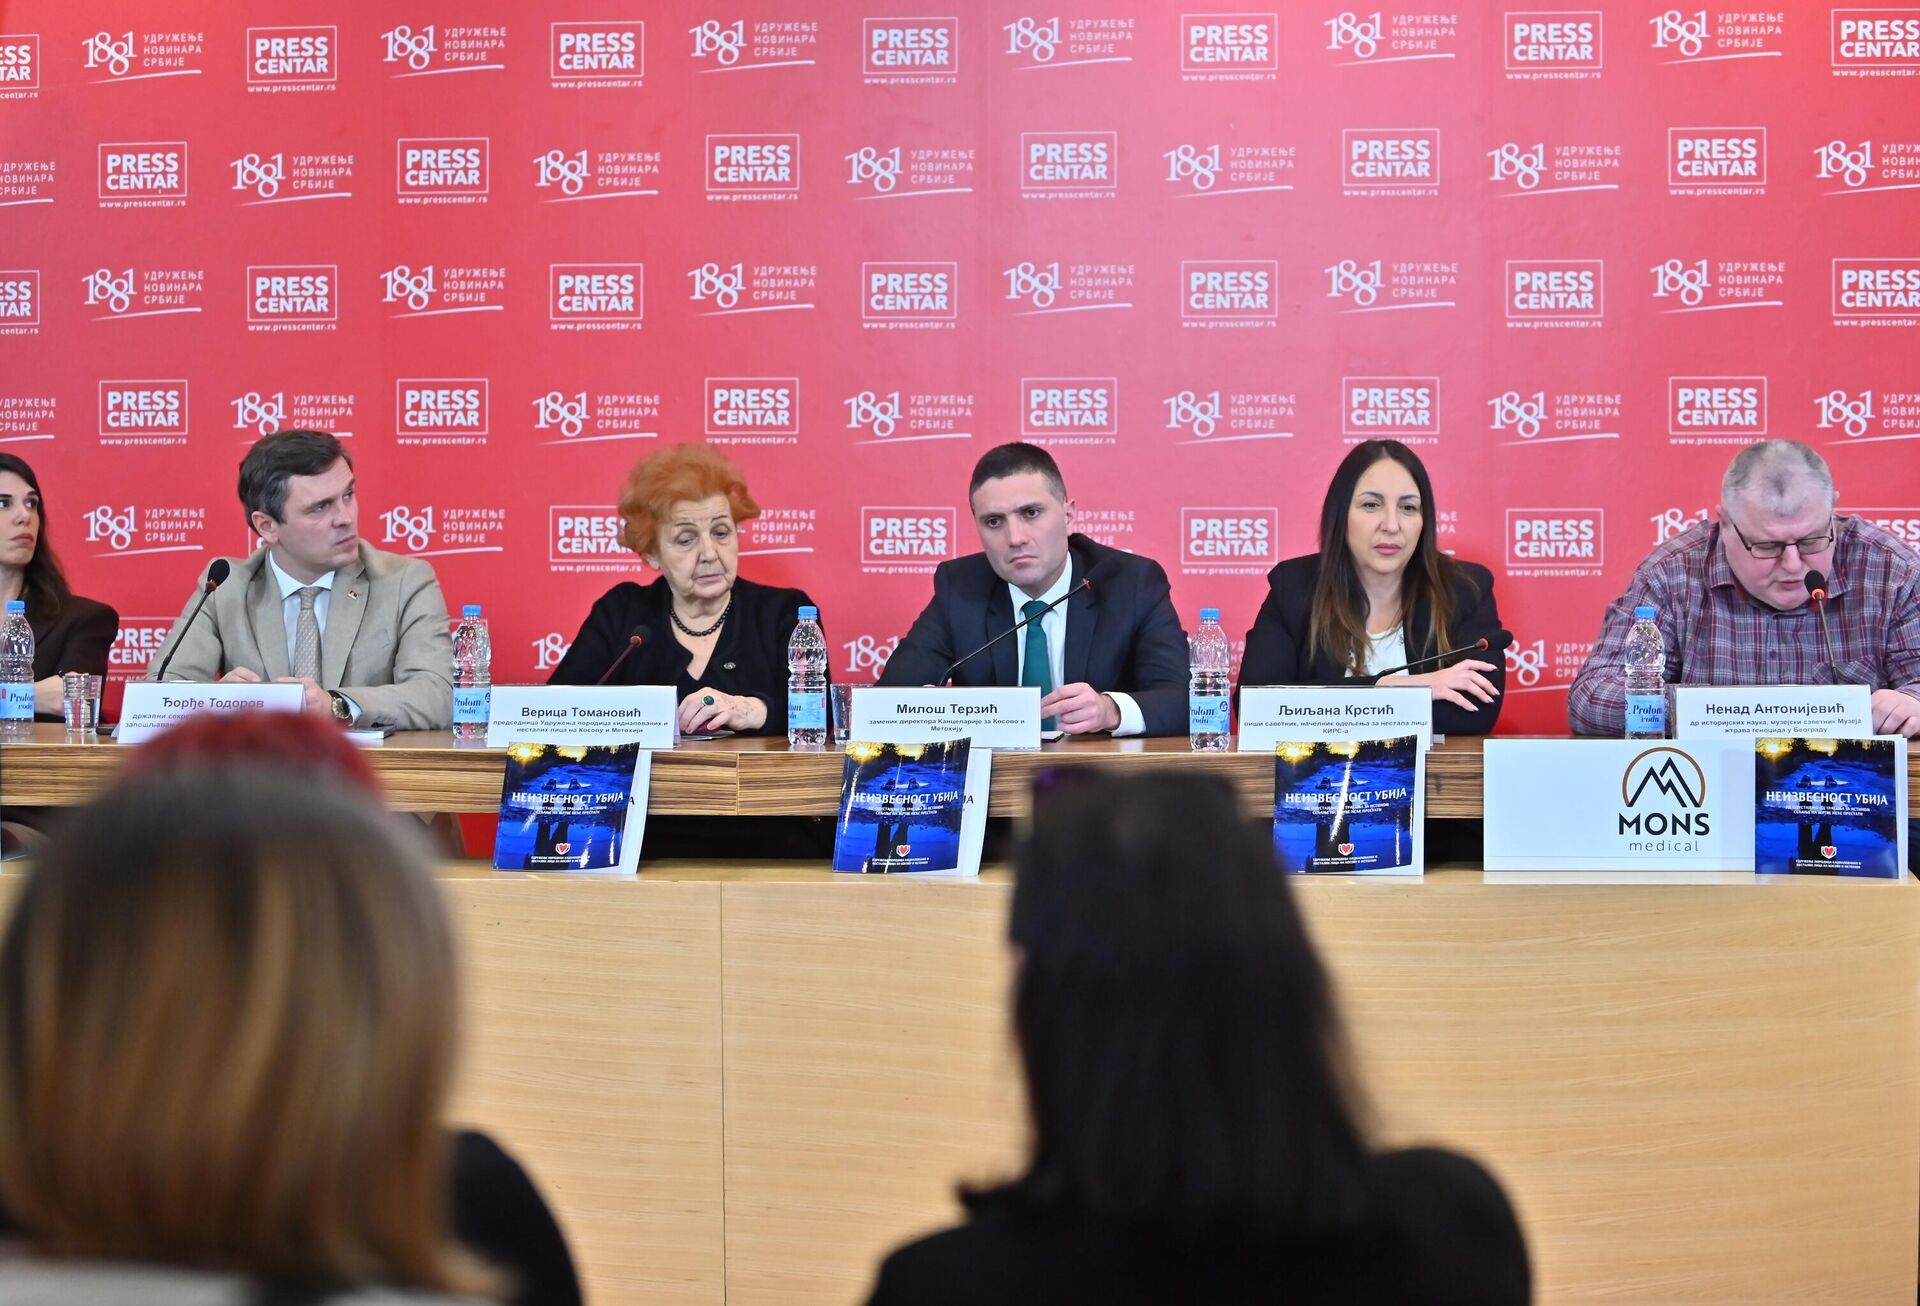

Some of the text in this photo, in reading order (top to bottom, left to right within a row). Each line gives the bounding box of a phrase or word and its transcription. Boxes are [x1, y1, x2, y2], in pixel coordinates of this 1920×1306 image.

[1392, 15, 1457, 25] УДРУЖЕЊЕ
[754, 22, 817, 33] УДРУЖЕЊЕ
[1392, 27, 1455, 37] НОВИНАРА
[1514, 23, 1593, 43] PRESS
[144, 32, 203, 44] УДРУЖЕЊЕ
[754, 35, 816, 44] НОВИНАРА
[872, 28, 949, 48] PRESS
[1324, 12, 1384, 57] 1881
[256, 37, 328, 57] PRESS
[689, 20, 747, 65] 1881
[1392, 40, 1436, 49] СРБИЈЕ
[82, 31, 136, 75] 1881
[144, 44, 202, 55] НОВИНАРА
[754, 47, 797, 56] СРБИЈЕ
[1514, 44, 1592, 61] CENTAR
[144, 57, 184, 67] СРБИЈЕ
[872, 50, 948, 65] CENTAR
[255, 57, 328, 74] CENTAR
[1506, 72, 1601, 80] www.presscentar.rs
[248, 84, 336, 93] www.presscentar.rs
[715, 145, 790, 165] PRESS
[912, 150, 974, 160] УДРУЖЕЊЕ
[1352, 140, 1430, 160] PRESS
[1555, 146, 1621, 156] УДРУЖЕЊЕ
[107, 152, 178, 173] PRESS
[293, 155, 354, 166] УДРУЖЕЊЕ
[911, 162, 973, 171] НОВИНАРА
[1487, 143, 1547, 189] 1881
[1555, 158, 1619, 168] НОВИНАРА
[230, 153, 286, 197] 1881
[293, 167, 352, 177] НОВИНАРА
[714, 166, 790, 182] CENTAR
[845, 147, 902, 192] 1881
[1351, 161, 1430, 177] CENTAR
[1555, 171, 1600, 180] СРБИЈЕ
[106, 173, 178, 190] CENTAR
[293, 179, 334, 189] СРБИЈЕ
[911, 175, 954, 183] СРБИЈЕ
[1344, 188, 1438, 196] www.presscentar.rs
[99, 200, 186, 208] www.presscentar.rs
[753, 266, 816, 276] УДРУЖЕЊЕ
[1393, 263, 1457, 273] УДРУЖЕЊЕ
[559, 274, 634, 295] PRESS
[688, 263, 746, 308] 1881
[753, 278, 814, 288] НОВИНАРА
[1191, 272, 1268, 291] PRESS
[1325, 260, 1384, 305] 1881
[1393, 276, 1456, 285] НОВИНАРА
[753, 290, 796, 300] СРБИЈЕ
[1393, 288, 1437, 297] СРБИЈЕ
[558, 296, 634, 312] CENTAR
[1190, 293, 1268, 309] CENTAR
[551, 323, 641, 331] www.presscentar.rs
[406, 389, 479, 409] PRESS
[597, 395, 660, 406] УДРУЖЕЊЕ
[1031, 389, 1107, 409] PRESS
[1231, 394, 1295, 404] УДРУЖЕЊЕ
[405, 409, 479, 426] CENTAR
[532, 392, 590, 437] 1881
[597, 407, 658, 417] НОВИНАРА
[1030, 410, 1107, 426] CENTAR
[1163, 391, 1222, 437] 1881
[1231, 407, 1294, 416] НОВИНАРА
[597, 419, 639, 429] СРБИЈЕ
[1231, 419, 1274, 428] СРБИЈЕ
[397, 437, 487, 445] www.presscentar.rs
[145, 508, 205, 519] УДРУЖЕЊЕ
[83, 505, 138, 550] 1881
[145, 520, 203, 530] НОВИНАРА
[871, 518, 947, 538] PRESS
[1515, 520, 1594, 540] PRESS
[145, 532, 186, 542] СРБИЈЕ
[869, 539, 946, 555] CENTAR
[1514, 541, 1593, 558] CENTAR
[1507, 569, 1602, 577] www.presscentar.rs
[162, 697, 264, 710] Ђорђе Тодоров
[896, 703, 998, 716] Милош Терзић
[1632, 704, 1662, 714] Prolom
[1706, 703, 1845, 716] Ненад Антонијевић
[521, 707, 641, 719] Верица Томановић
[1278, 704, 1394, 717] Љиљана Крстић
[511, 792, 593, 804] НЕИЗВЕСНОСТ
[595, 791, 624, 803] УБИЈА
[853, 792, 932, 804] НЕИЗВЕСНОСТ
[932, 790, 959, 802] УБИЈА
[1375, 787, 1407, 801] УБИЈА
[1766, 791, 1888, 806] НЕИЗВЕСНОСТ УБИЈА
[1619, 813, 1710, 836] MONS
[1629, 840, 1699, 851] medical
